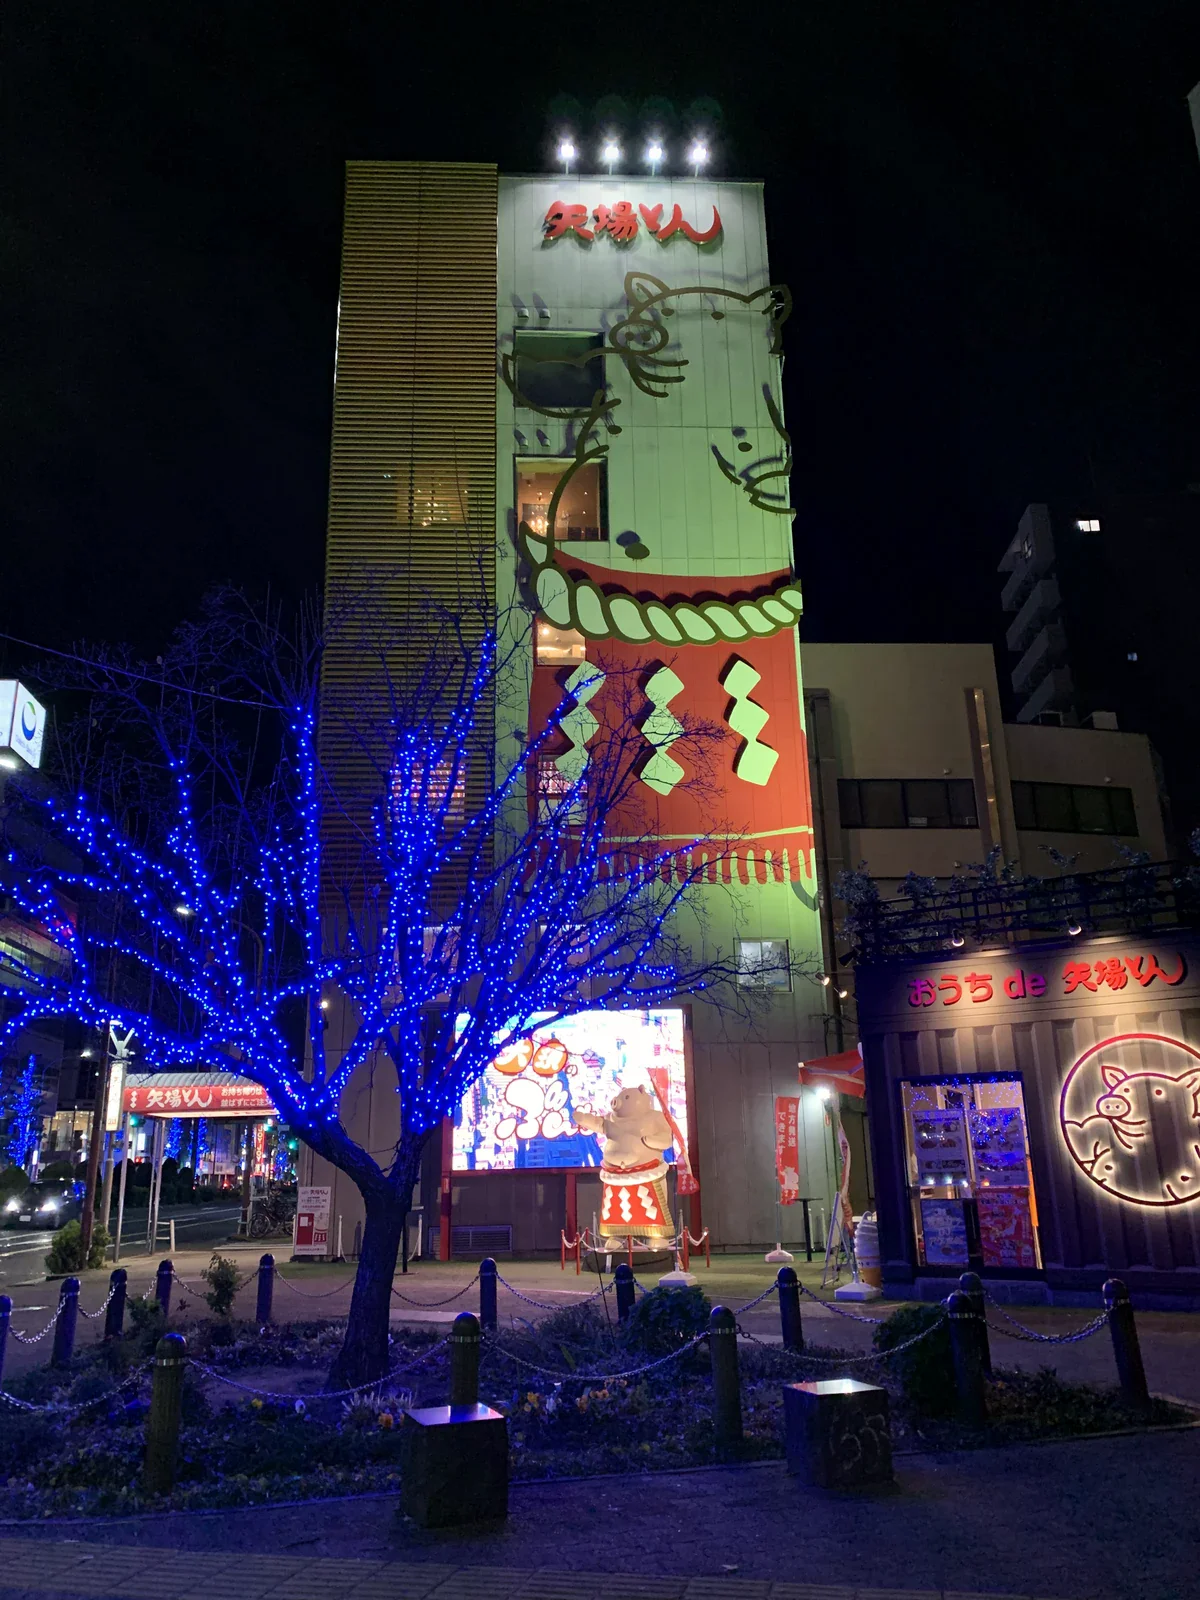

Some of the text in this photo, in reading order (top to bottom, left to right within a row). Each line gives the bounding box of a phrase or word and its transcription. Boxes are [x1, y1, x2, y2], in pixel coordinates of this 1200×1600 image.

[543, 200, 722, 244] 矢場とん
[908, 953, 1187, 1007] おうち de 矢場とん
[145, 1088, 213, 1108] 矢場とん
[788, 1103, 797, 1147] 地方発送
